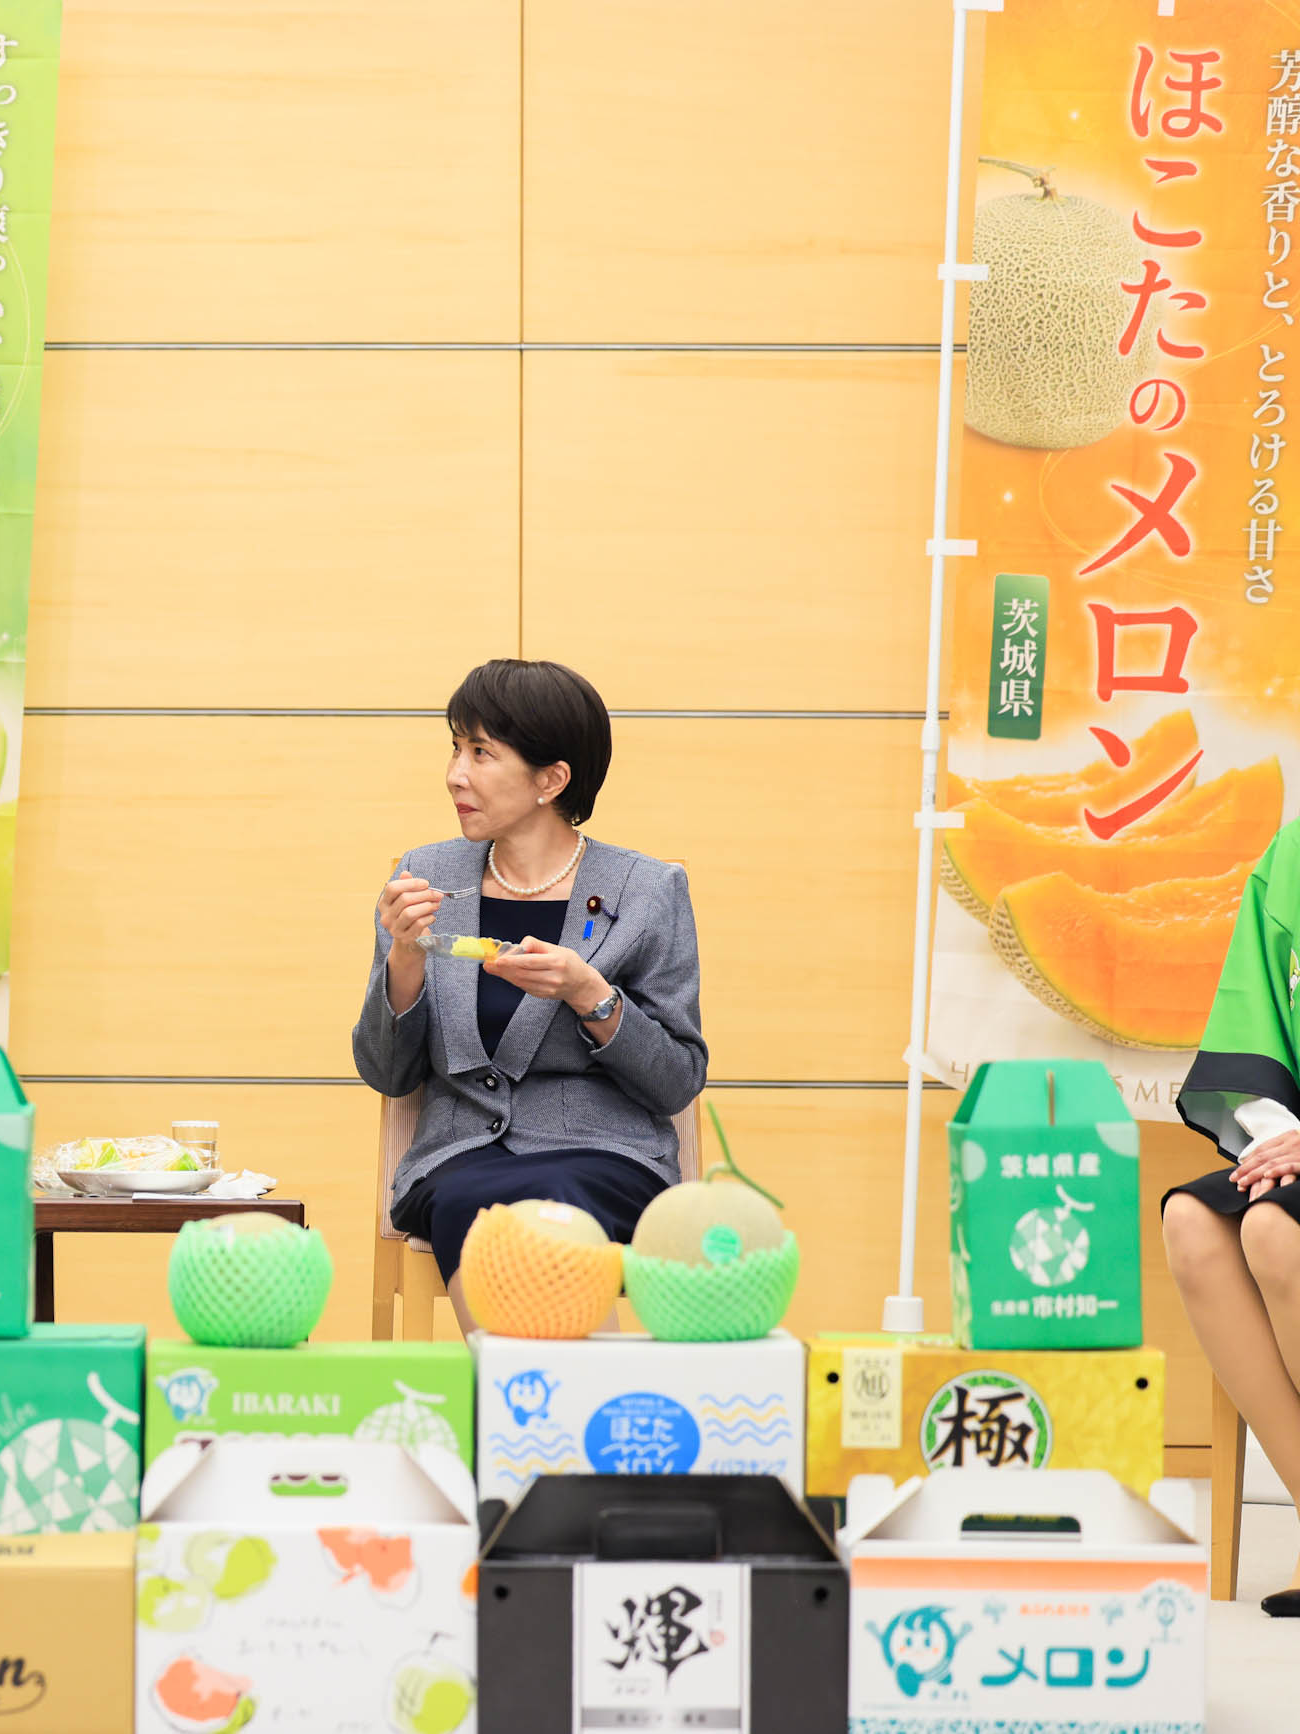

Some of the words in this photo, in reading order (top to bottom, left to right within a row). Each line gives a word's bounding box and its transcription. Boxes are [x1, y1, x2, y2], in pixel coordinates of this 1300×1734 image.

[1079, 45, 1223, 840] ほこたのメロン
[998, 598, 1040, 717] 茨城県
[232, 1391, 341, 1416] IBARAKI
[610, 1416, 675, 1442] ほこた
[930, 1385, 1035, 1467] 極
[602, 1585, 709, 1691] 輝
[981, 1647, 1150, 1689] メロン
